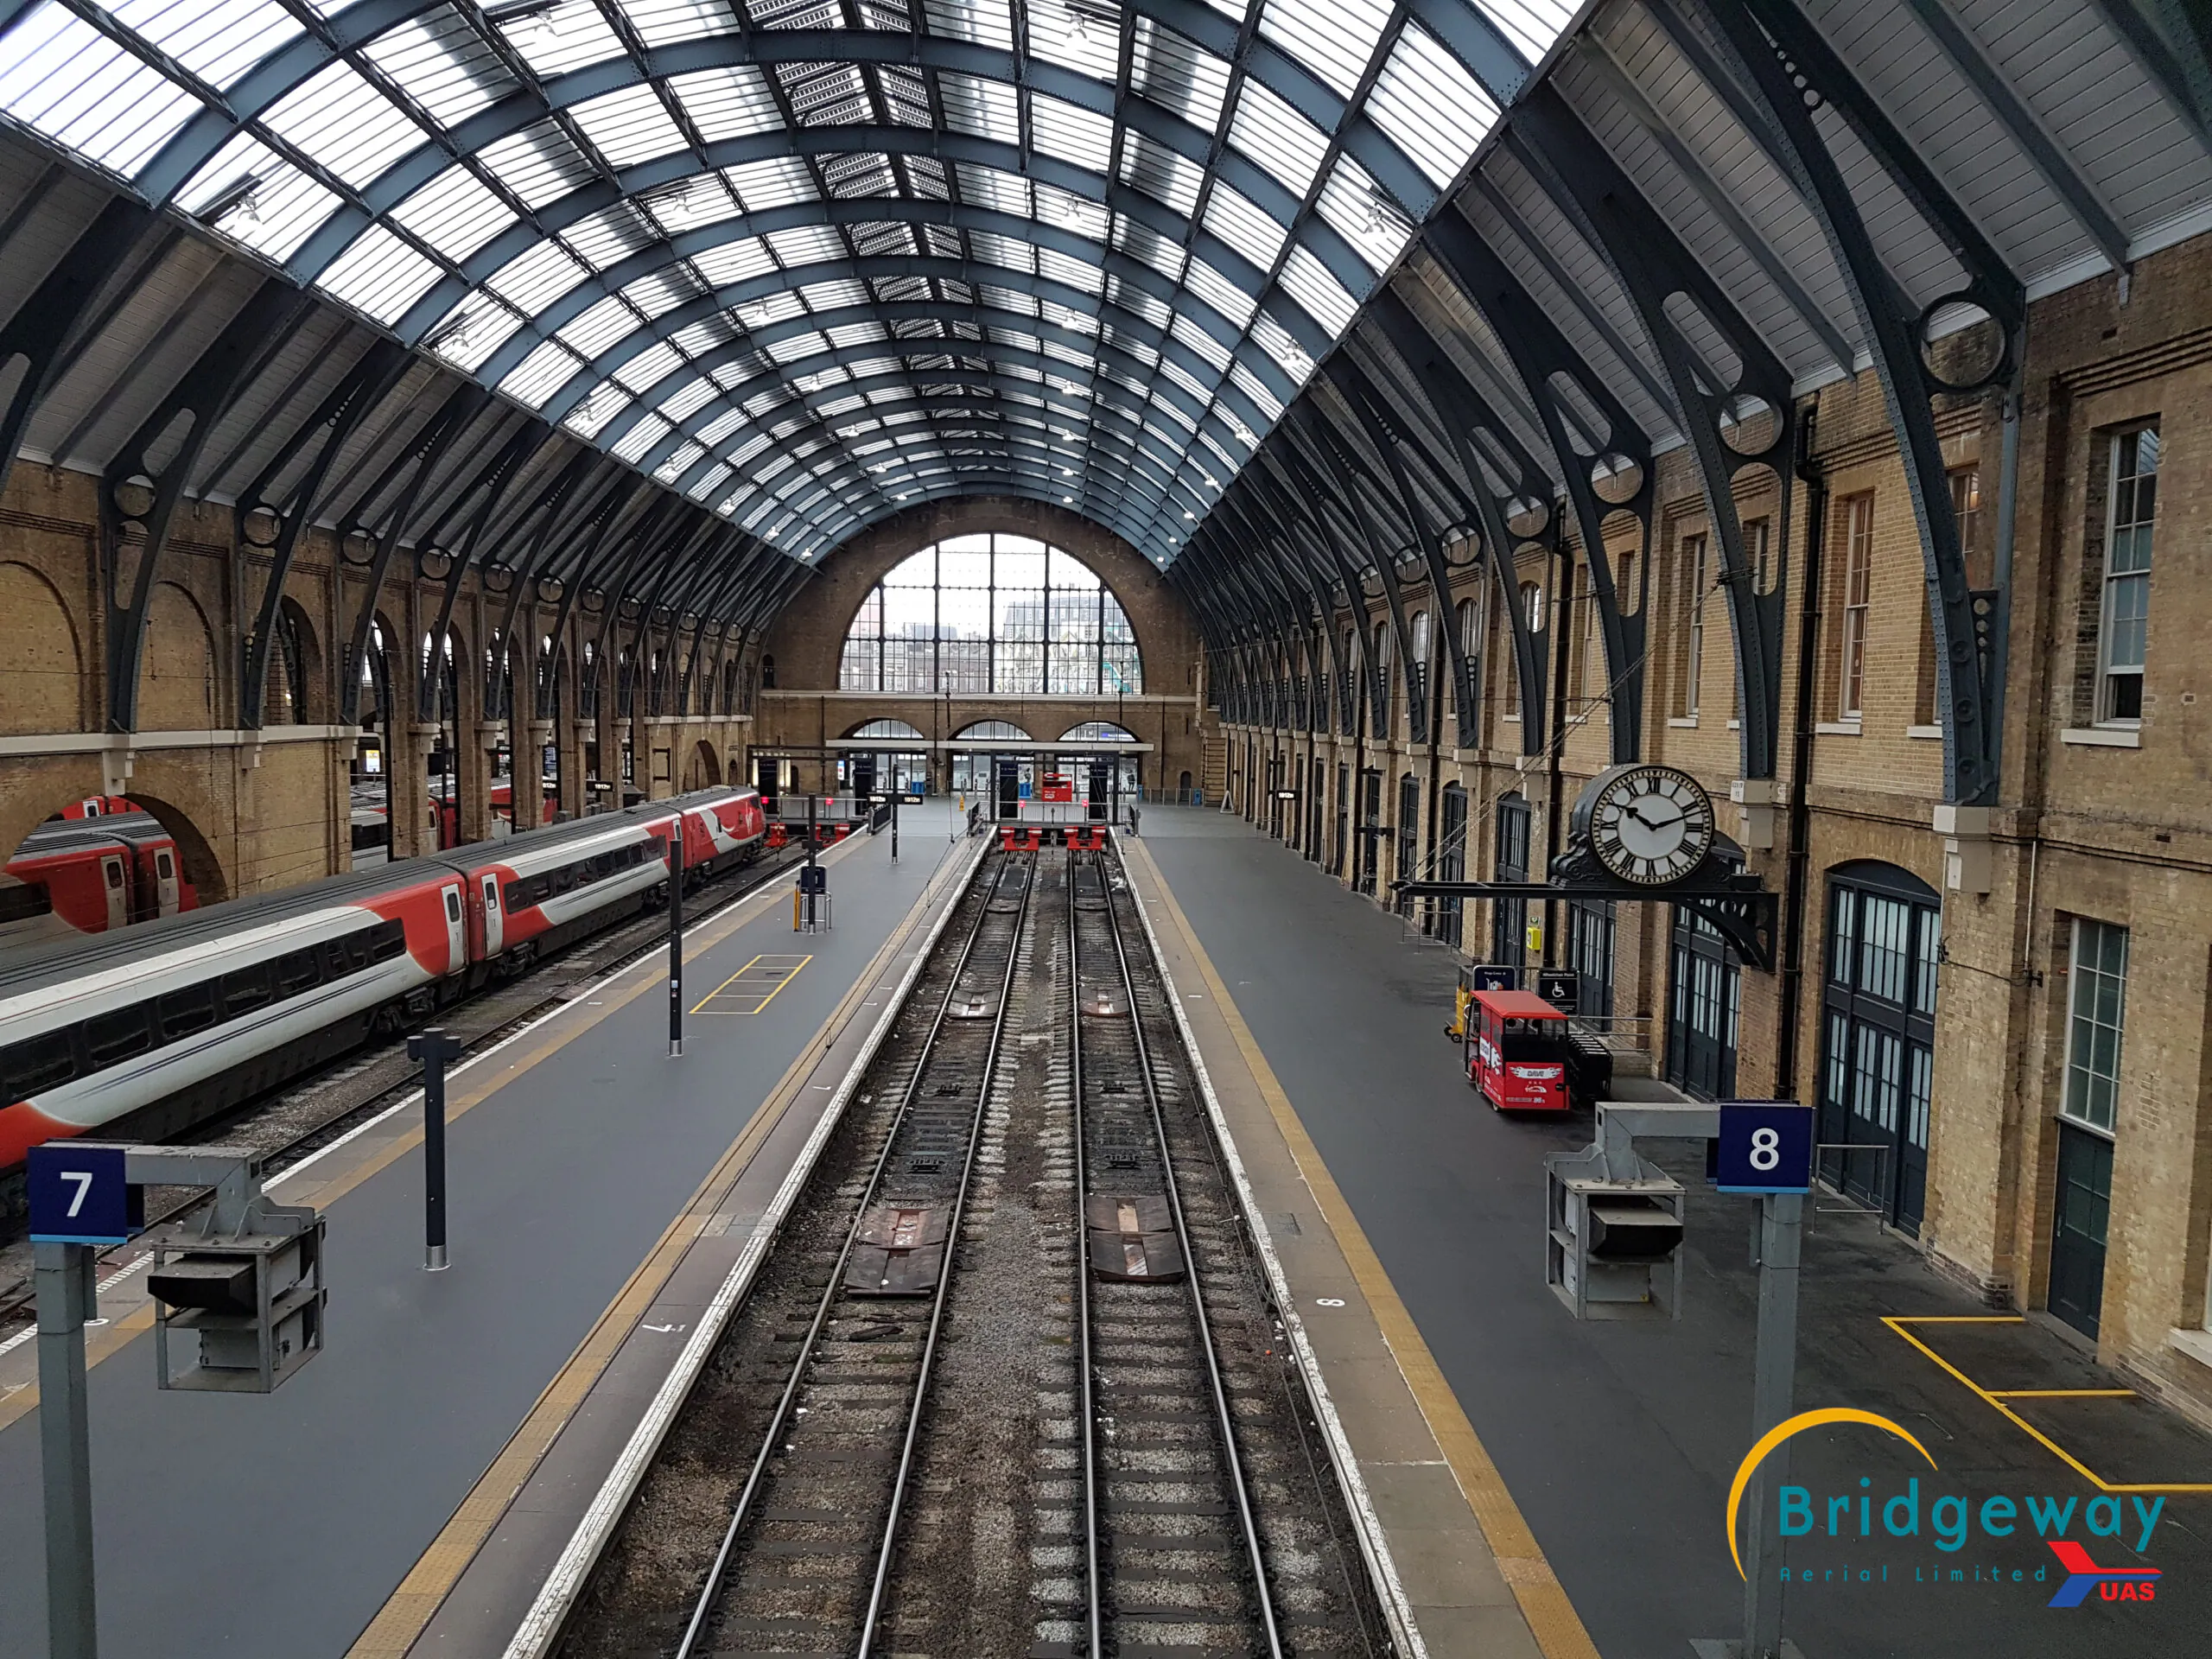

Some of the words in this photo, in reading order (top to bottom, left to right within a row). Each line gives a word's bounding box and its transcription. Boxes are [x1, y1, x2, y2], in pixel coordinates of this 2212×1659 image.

[1647, 777, 1662, 794] XII
[1749, 1128, 1779, 1171] 8
[60, 1171, 93, 1217] 7
